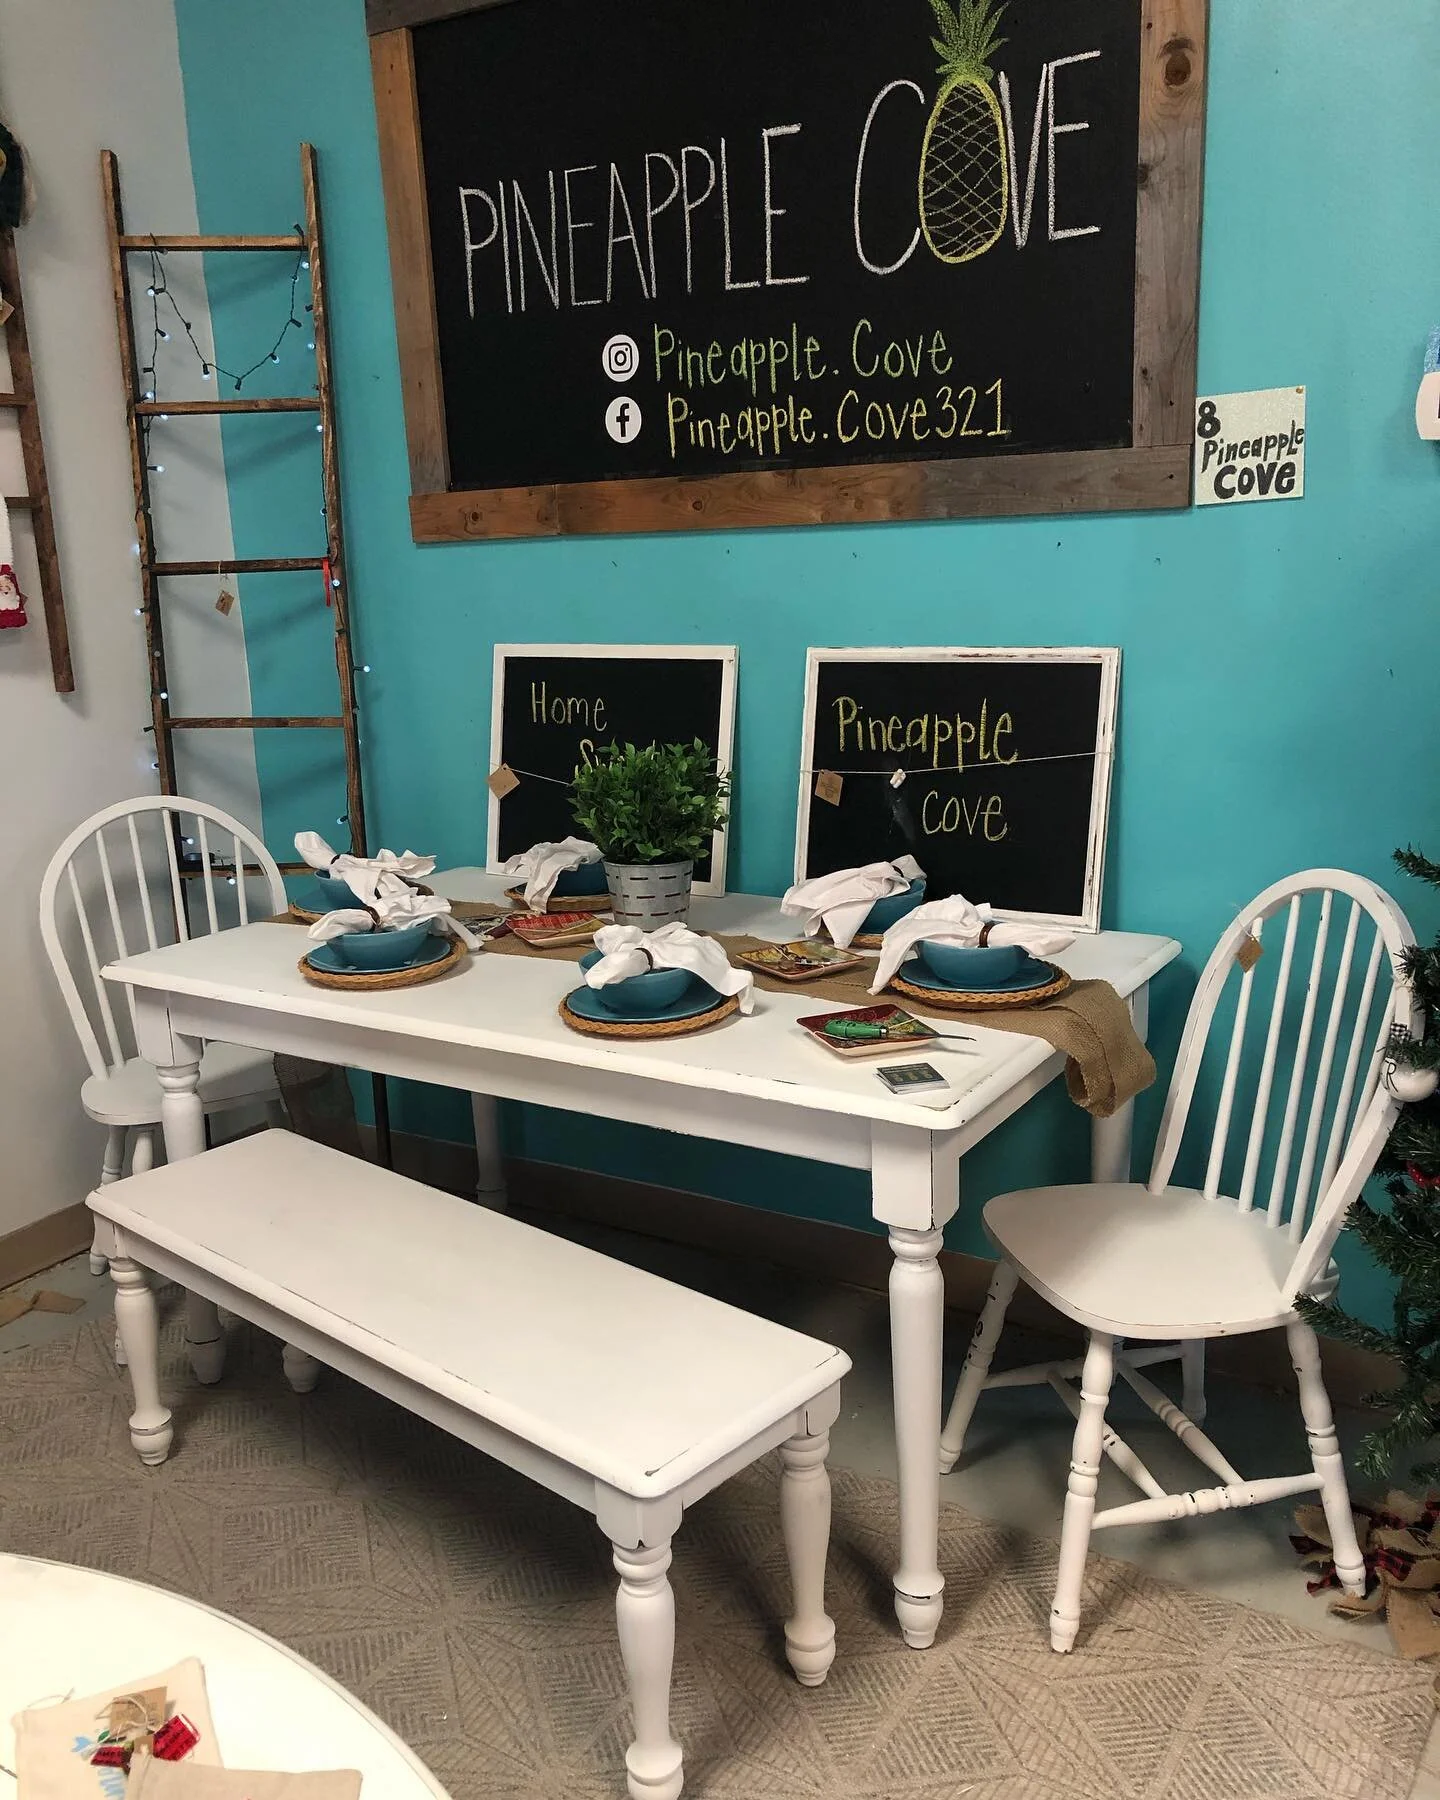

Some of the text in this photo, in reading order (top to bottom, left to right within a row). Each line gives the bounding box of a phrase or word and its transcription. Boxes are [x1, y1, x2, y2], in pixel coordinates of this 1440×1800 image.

[459, 51, 1100, 319] PINEAPPLE COVE
[1197, 400, 1221, 439] 8
[530, 681, 608, 733] Home
[832, 695, 1019, 773] Pineapple
